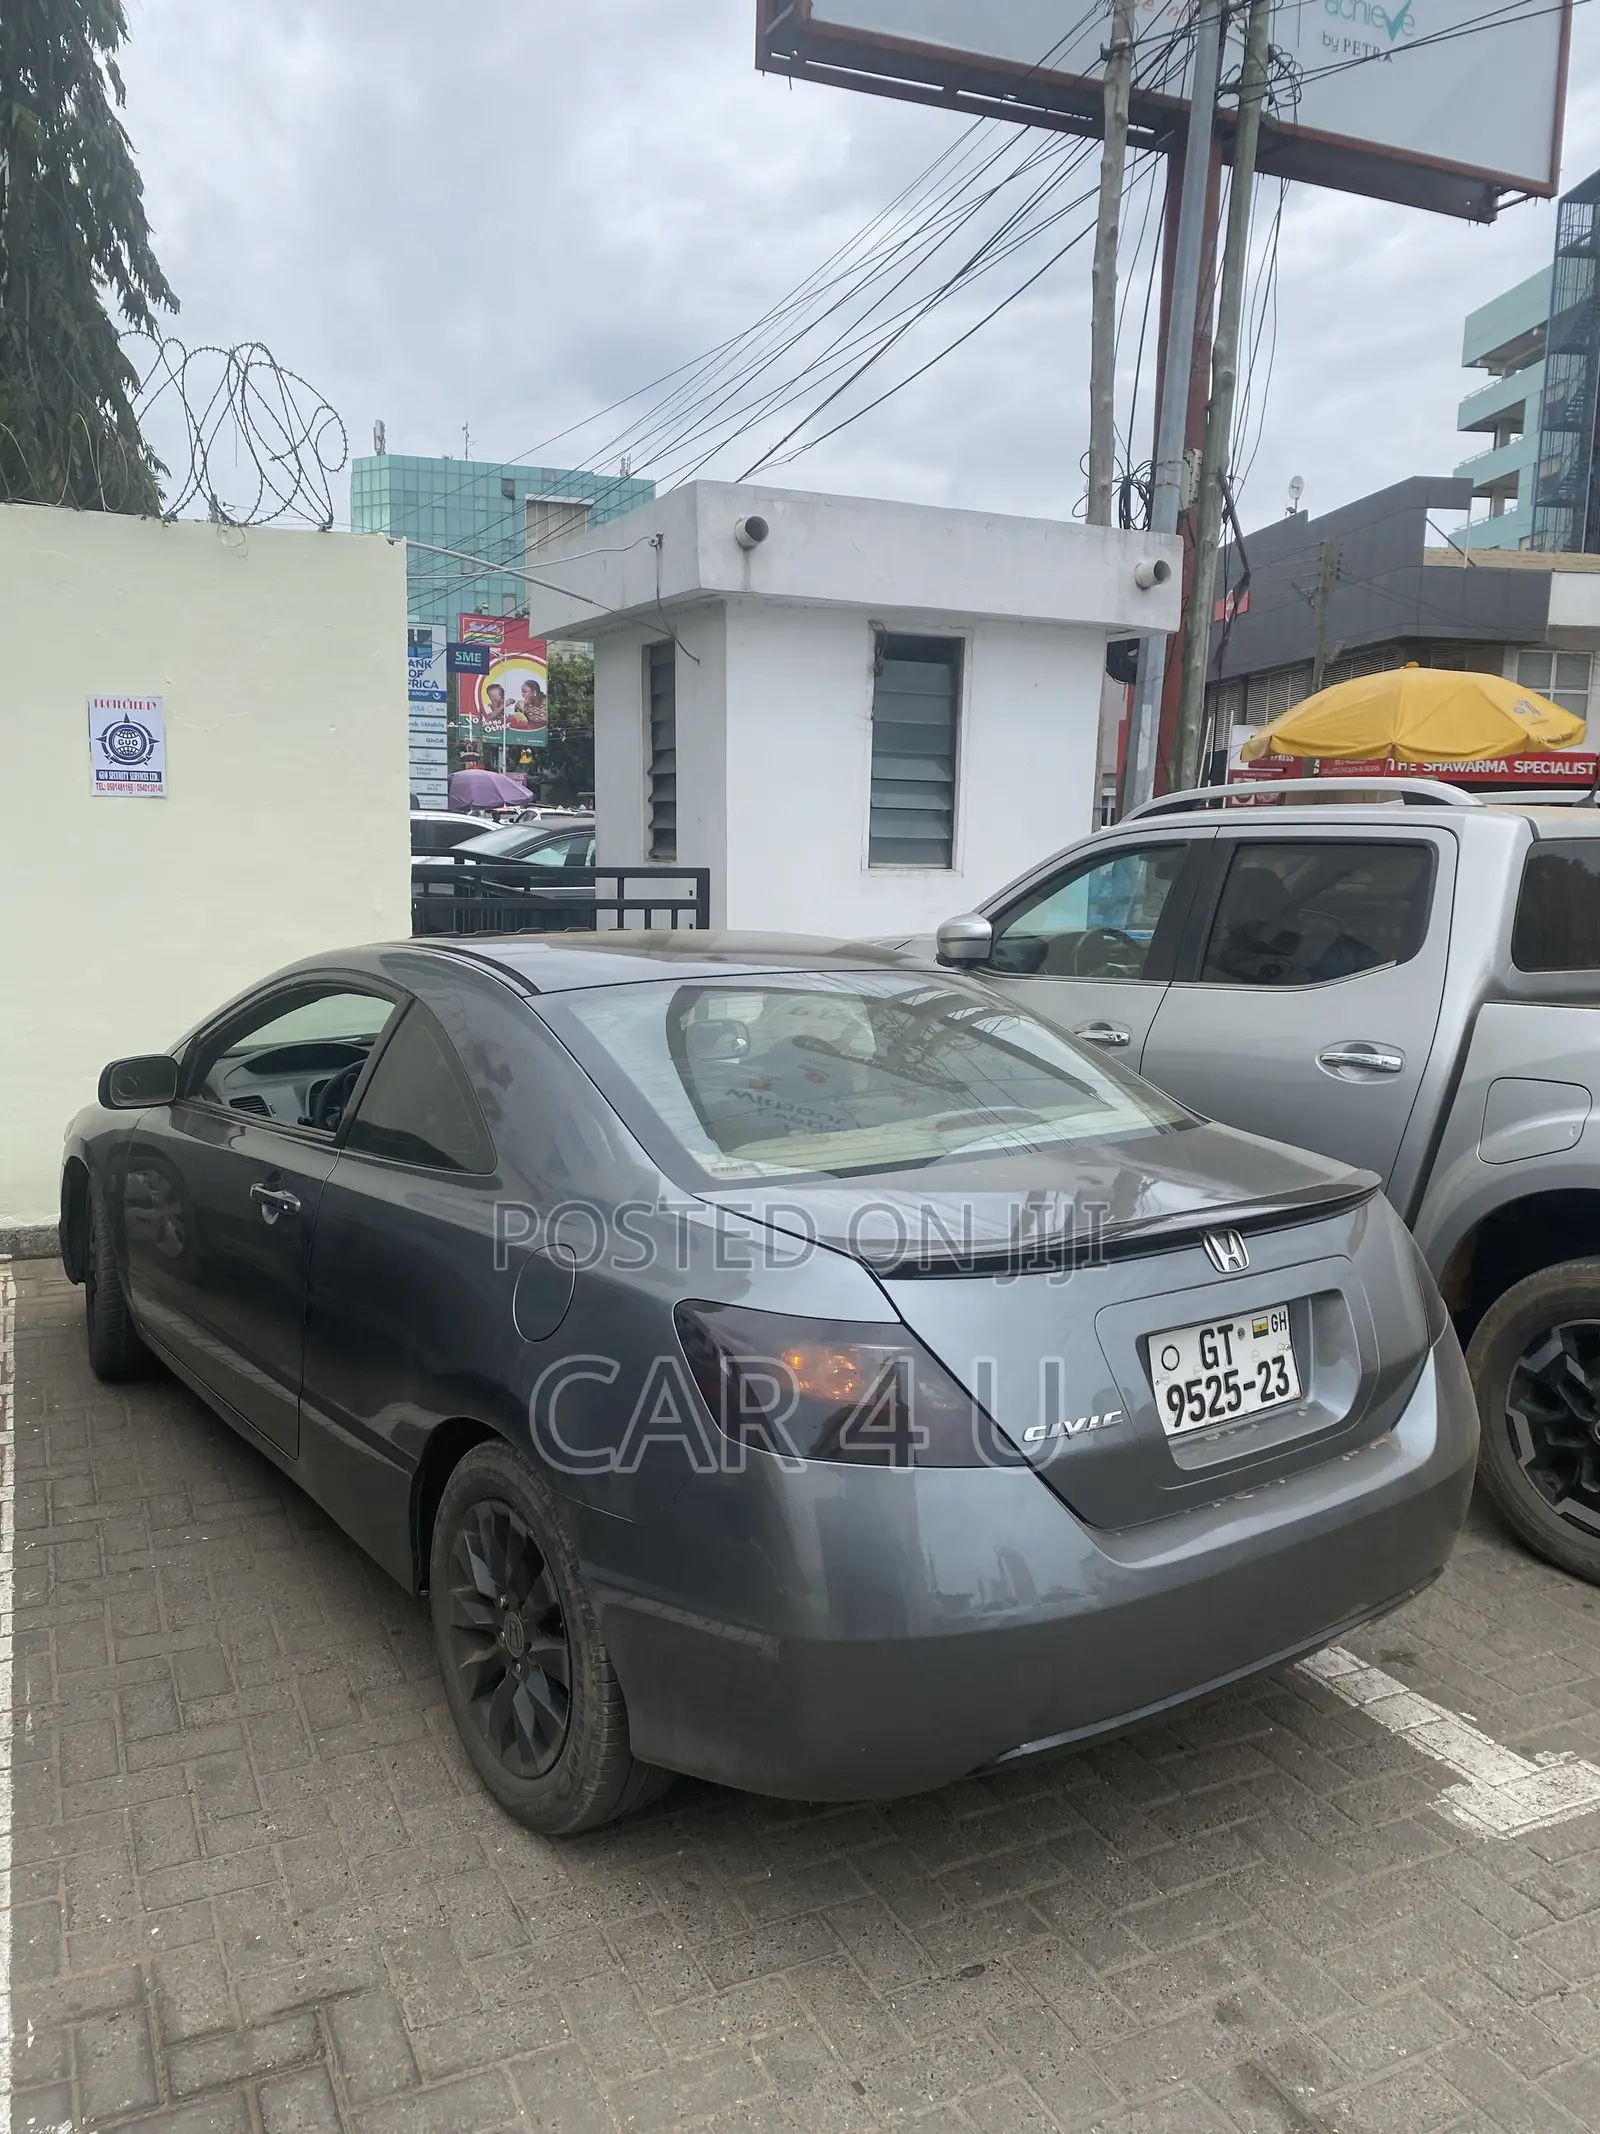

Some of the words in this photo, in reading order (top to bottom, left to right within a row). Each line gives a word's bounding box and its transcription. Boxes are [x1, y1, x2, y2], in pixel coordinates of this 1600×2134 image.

[1322, 30, 1339, 52] by
[408, 659, 432, 668] ANK
[455, 651, 482, 663] SME
[408, 669, 424, 678] OF
[118, 738, 138, 746] GUO
[1387, 758, 1417, 771] THE
[1422, 760, 1508, 773] SHAWARMA
[1513, 760, 1597, 775] SPECIALIST
[1199, 1323, 1235, 1371] GT
[1270, 1311, 1288, 1335] GH
[1166, 1355, 1291, 1428] 9525-23
[1023, 1410, 1124, 1442] CIVIC
